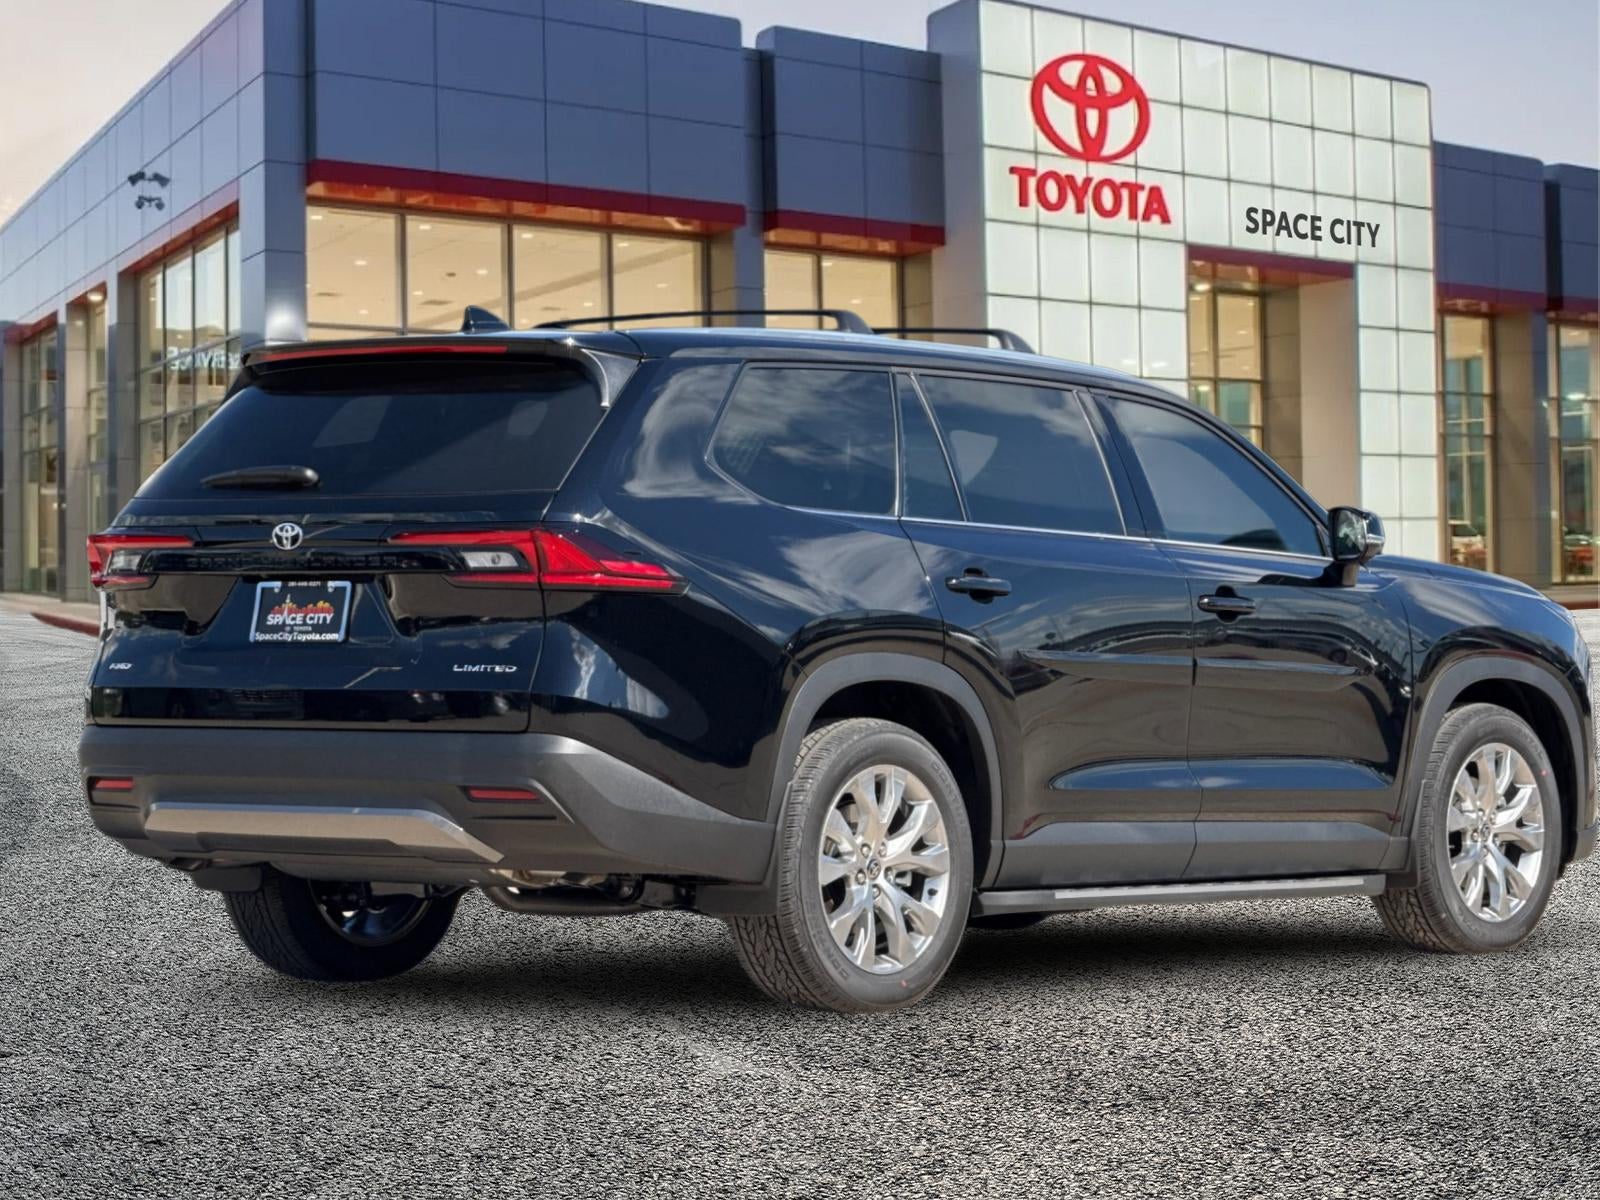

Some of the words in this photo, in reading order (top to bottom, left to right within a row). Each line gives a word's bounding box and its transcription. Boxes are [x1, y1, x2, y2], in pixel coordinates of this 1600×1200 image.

[1009, 166, 1171, 225] TOYOTA
[1245, 207, 1322, 242] SPACE
[1329, 217, 1381, 248] CITY
[266, 613, 304, 625] SPACE
[305, 613, 334, 624] CITY
[255, 632, 339, 642] SpaceCityToyota.com
[453, 664, 518, 673] LIMITED
